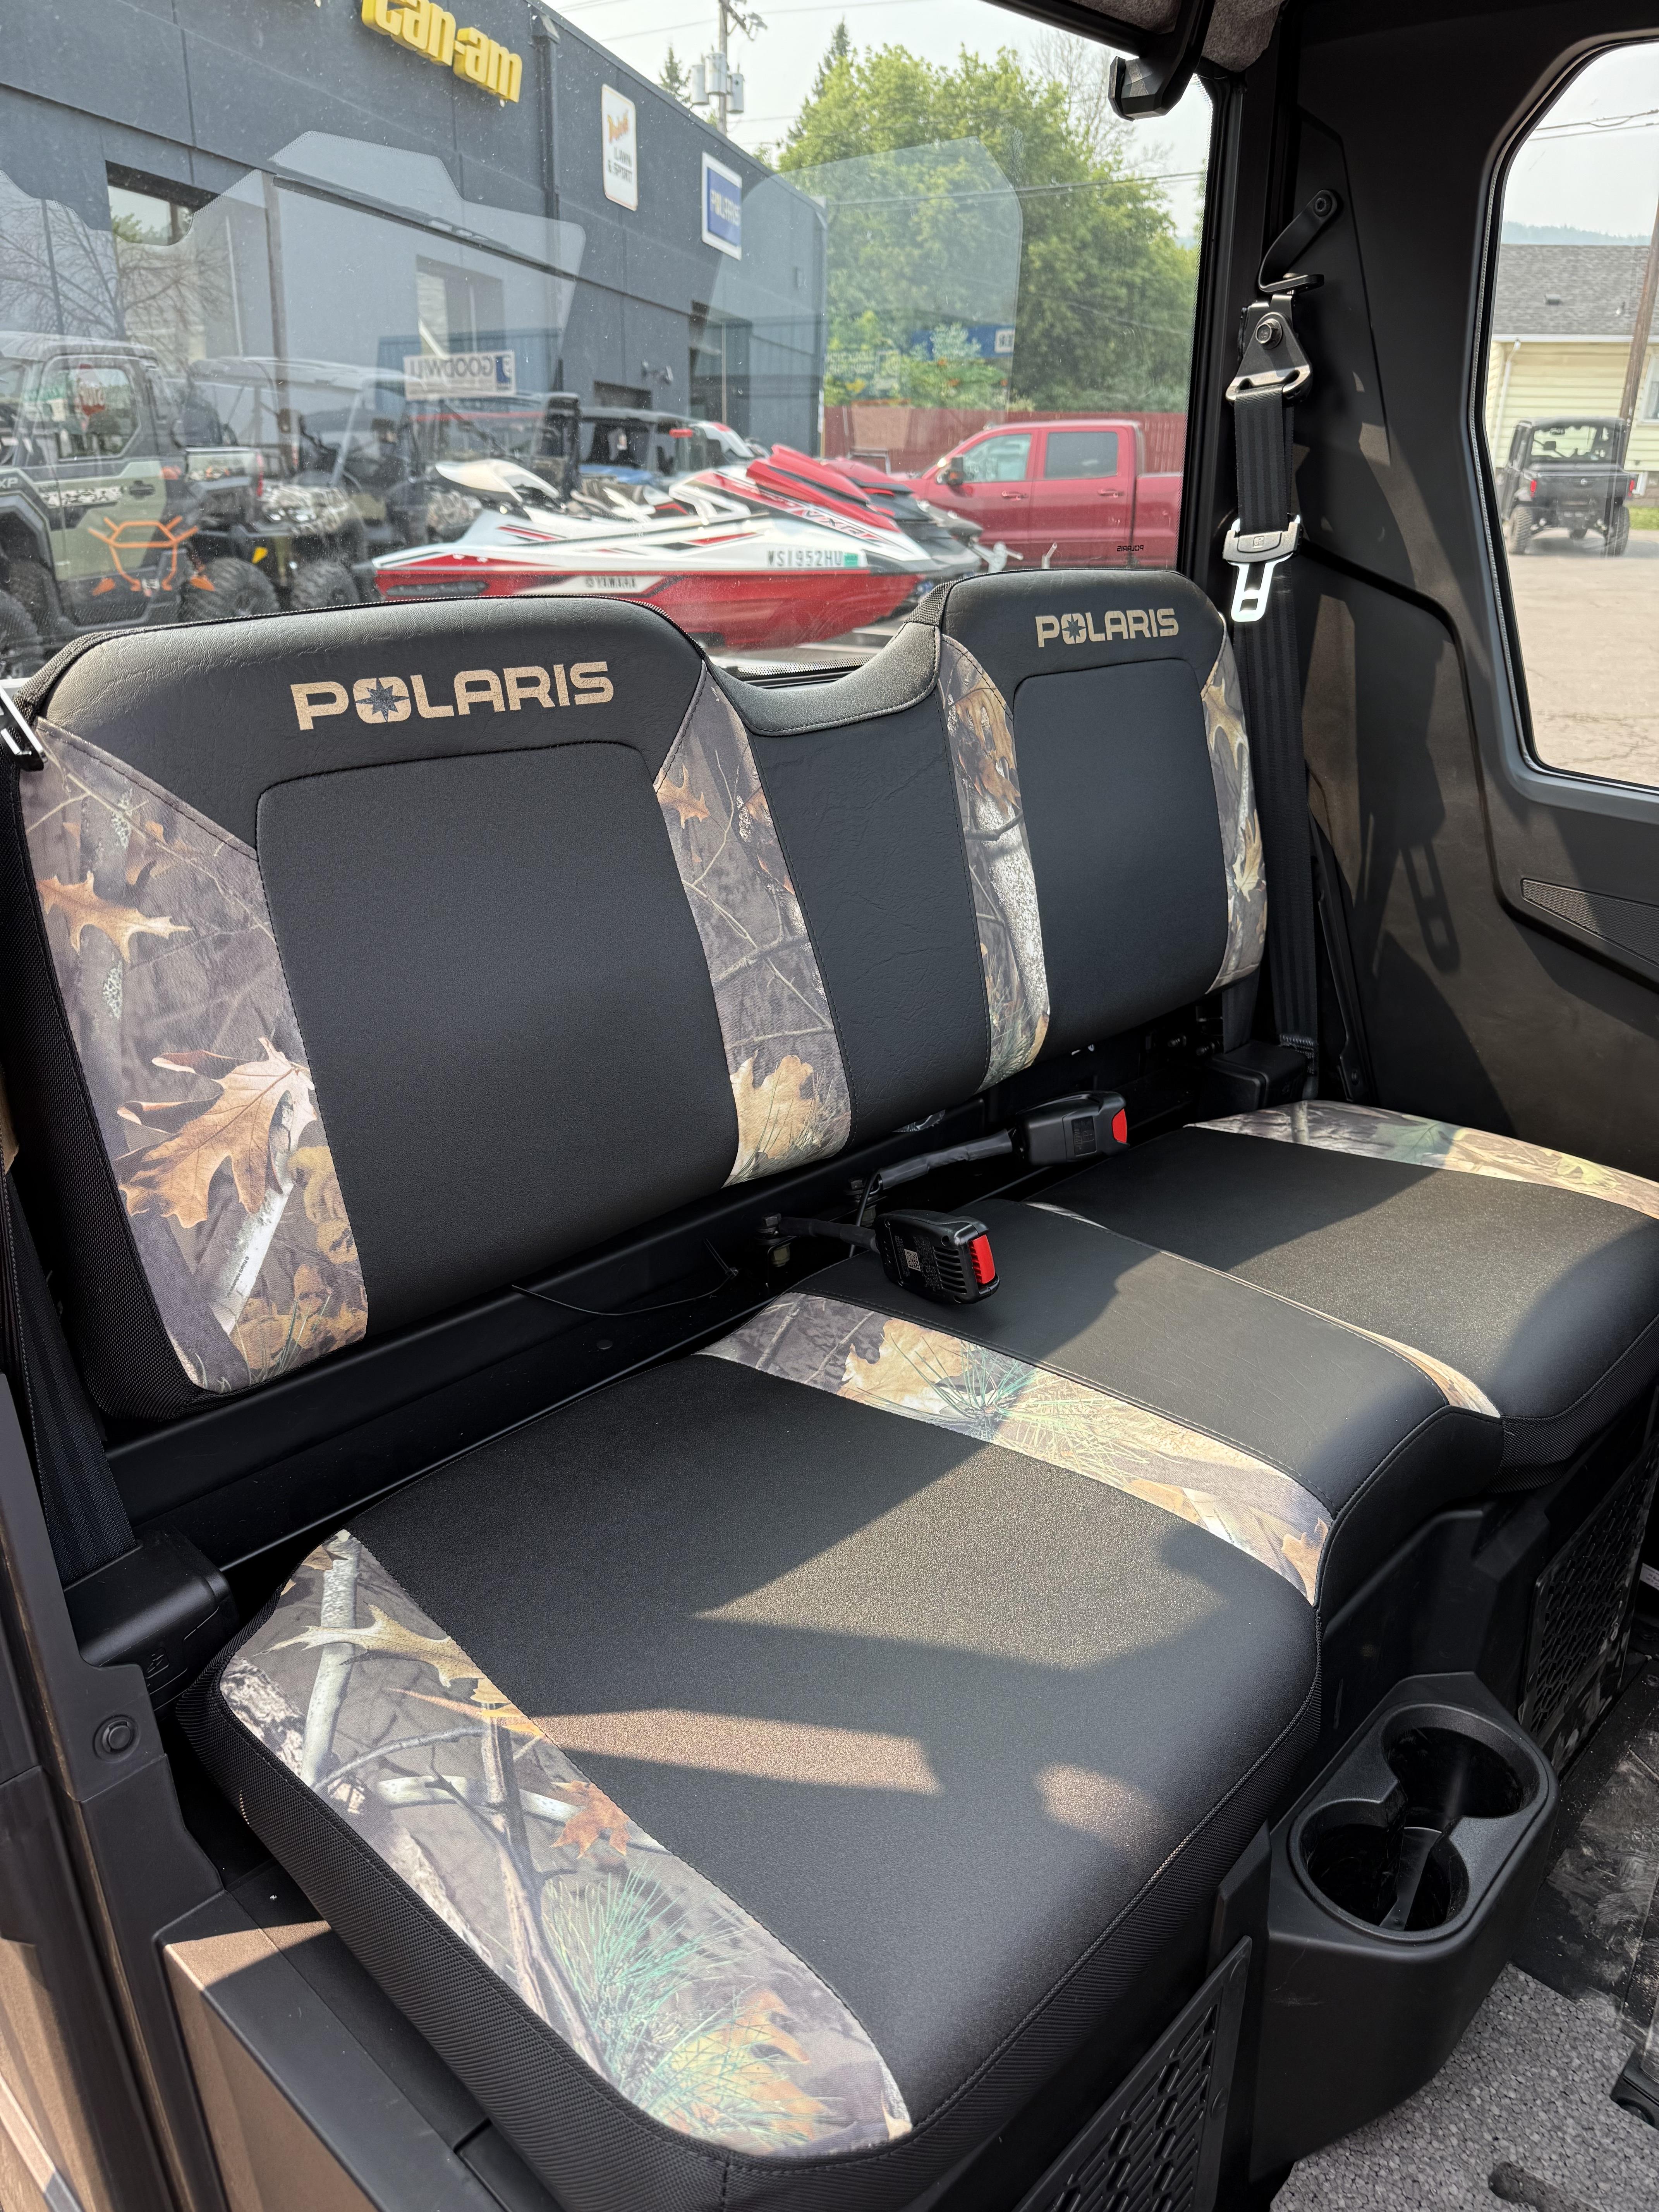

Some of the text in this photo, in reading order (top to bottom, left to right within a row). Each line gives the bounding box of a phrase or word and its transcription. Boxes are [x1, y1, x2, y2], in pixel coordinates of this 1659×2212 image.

[710, 189, 741, 227] POLARIS
[1035, 608, 1179, 647] POLARIS
[290, 661, 614, 730] POLARIS
